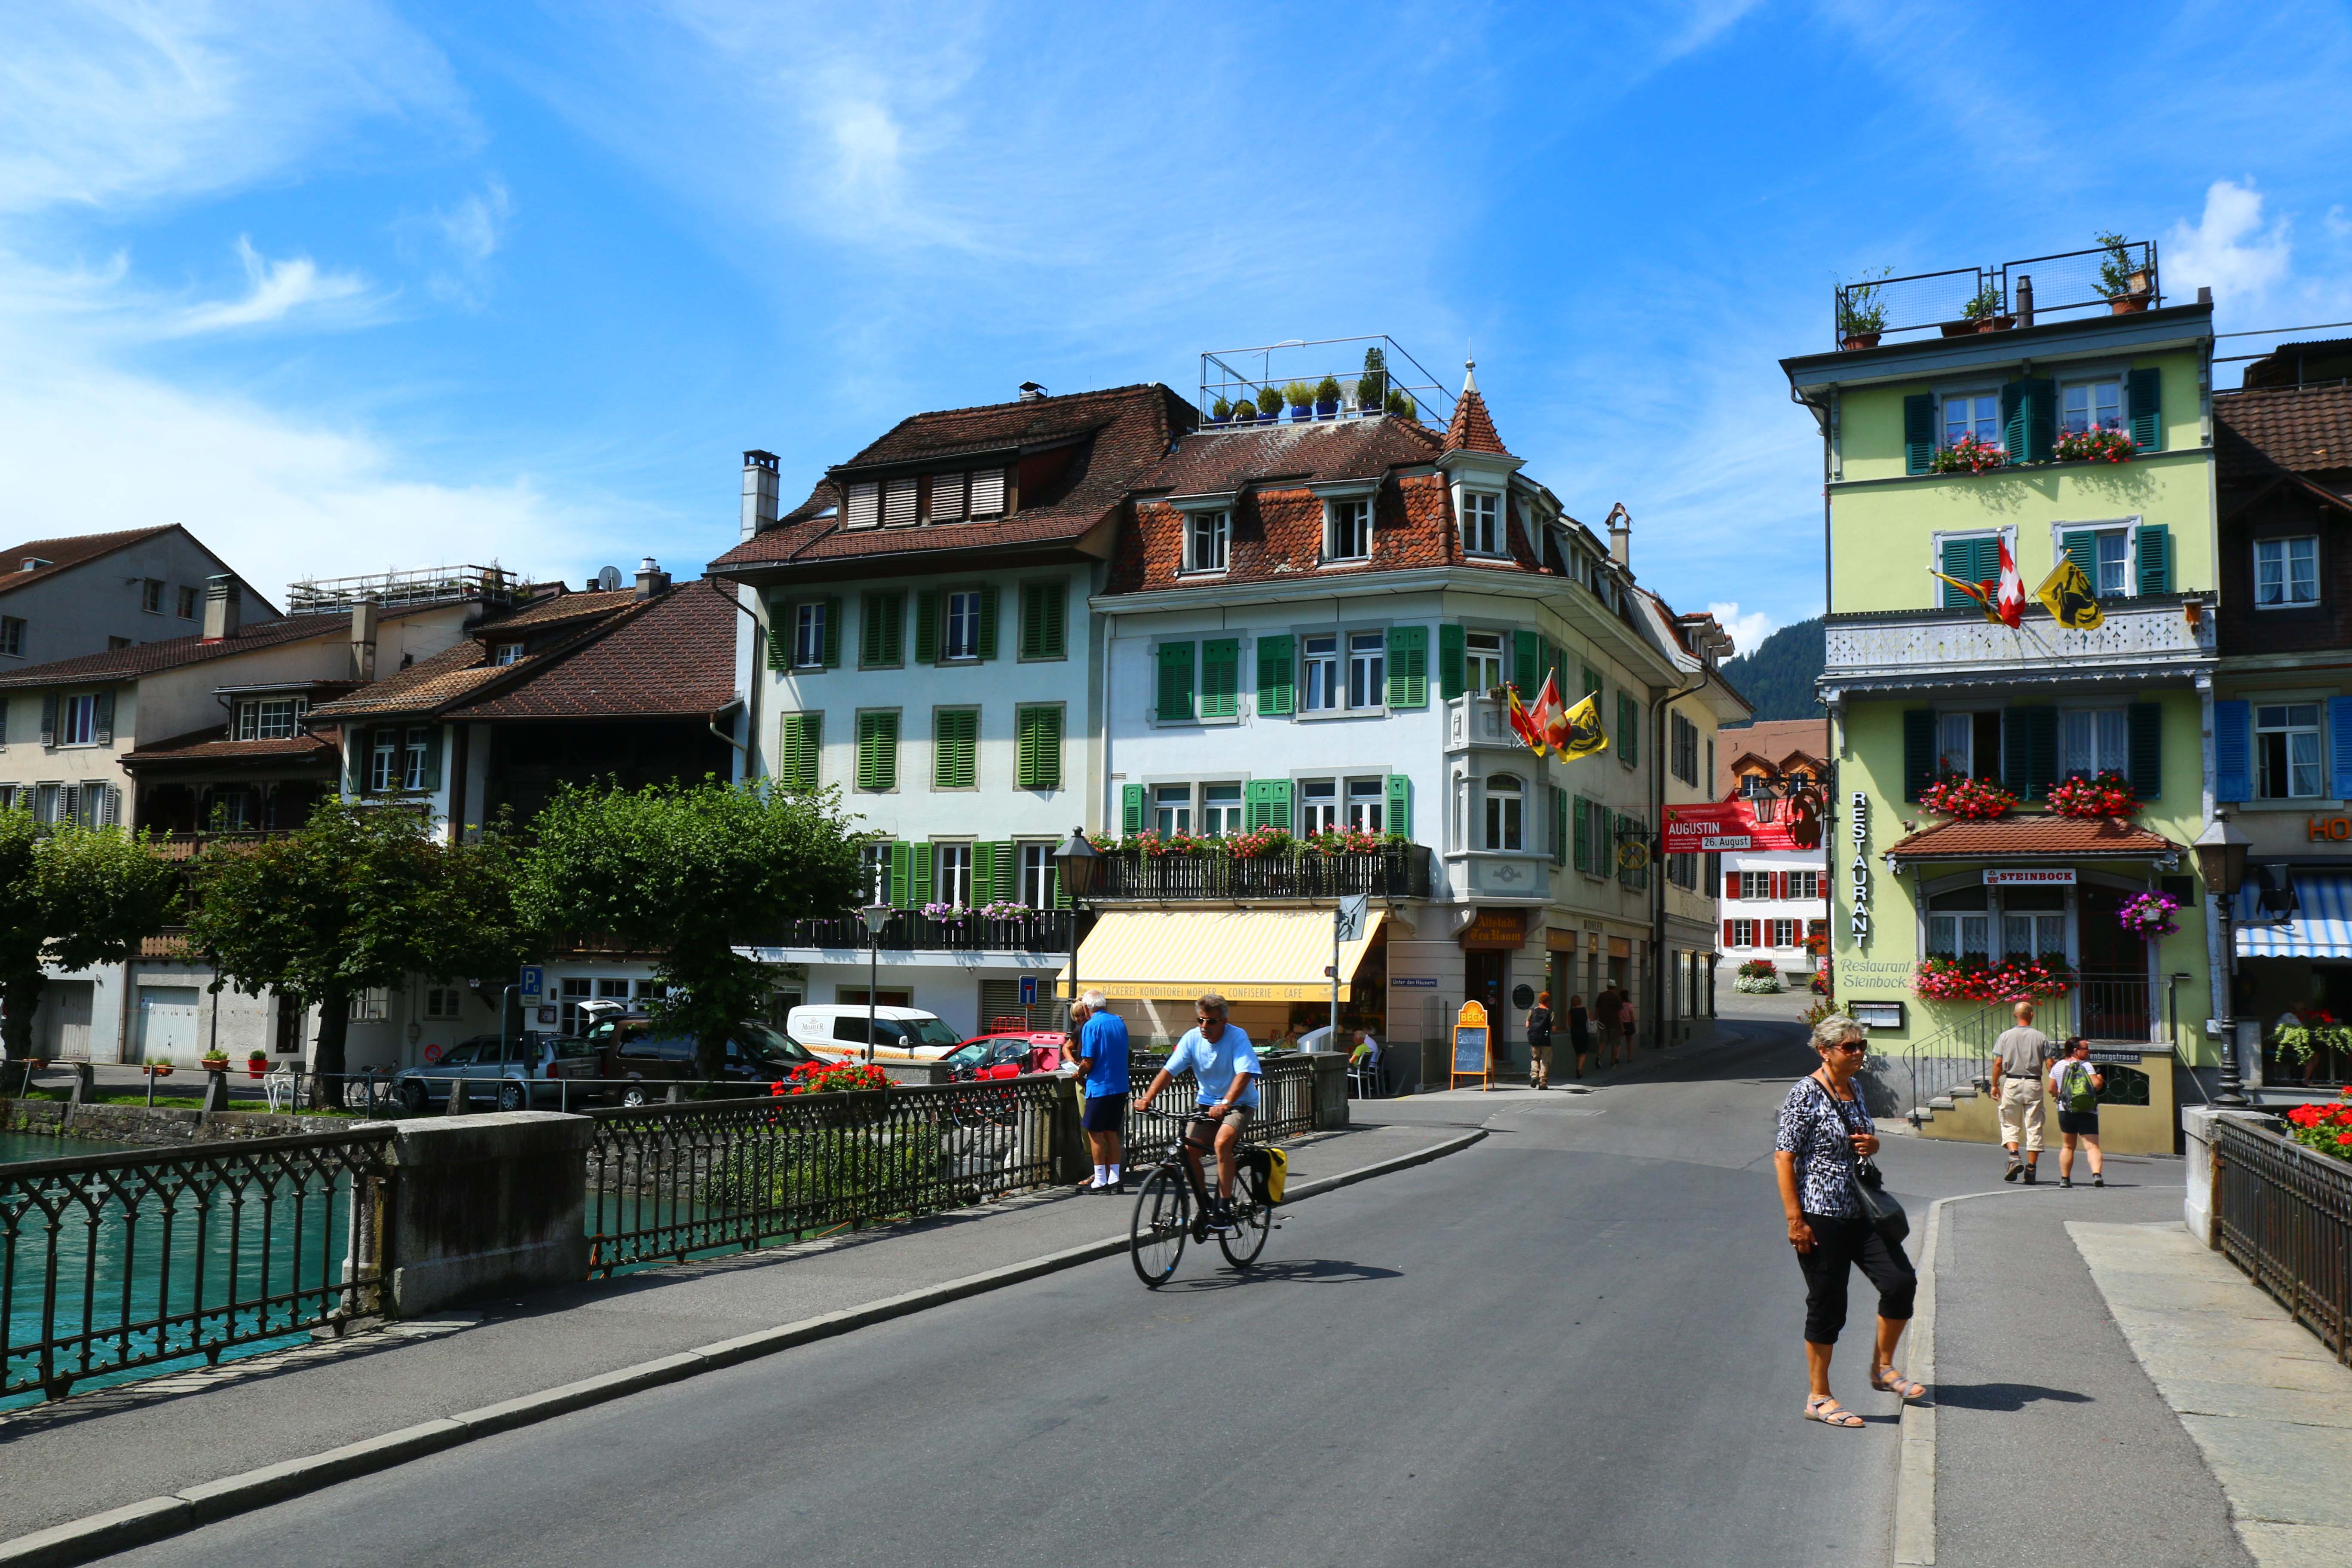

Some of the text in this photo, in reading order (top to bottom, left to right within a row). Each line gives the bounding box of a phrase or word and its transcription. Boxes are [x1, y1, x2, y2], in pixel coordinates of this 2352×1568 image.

[2308, 818, 2352, 839] HO
[1705, 836, 1748, 848] 26. August
[1851, 791, 1868, 947] RESTAURANT
[2000, 872, 2073, 881] STEINBOCK
[1841, 959, 1911, 973] Restaurant
[1844, 974, 1907, 988] Steinbock
[1228, 987, 1271, 998] CONFISERIE
[1284, 985, 1302, 998] CAFÉ
[1461, 1013, 1485, 1022] BECK
[2088, 1053, 2138, 1061] enbergstrasse
